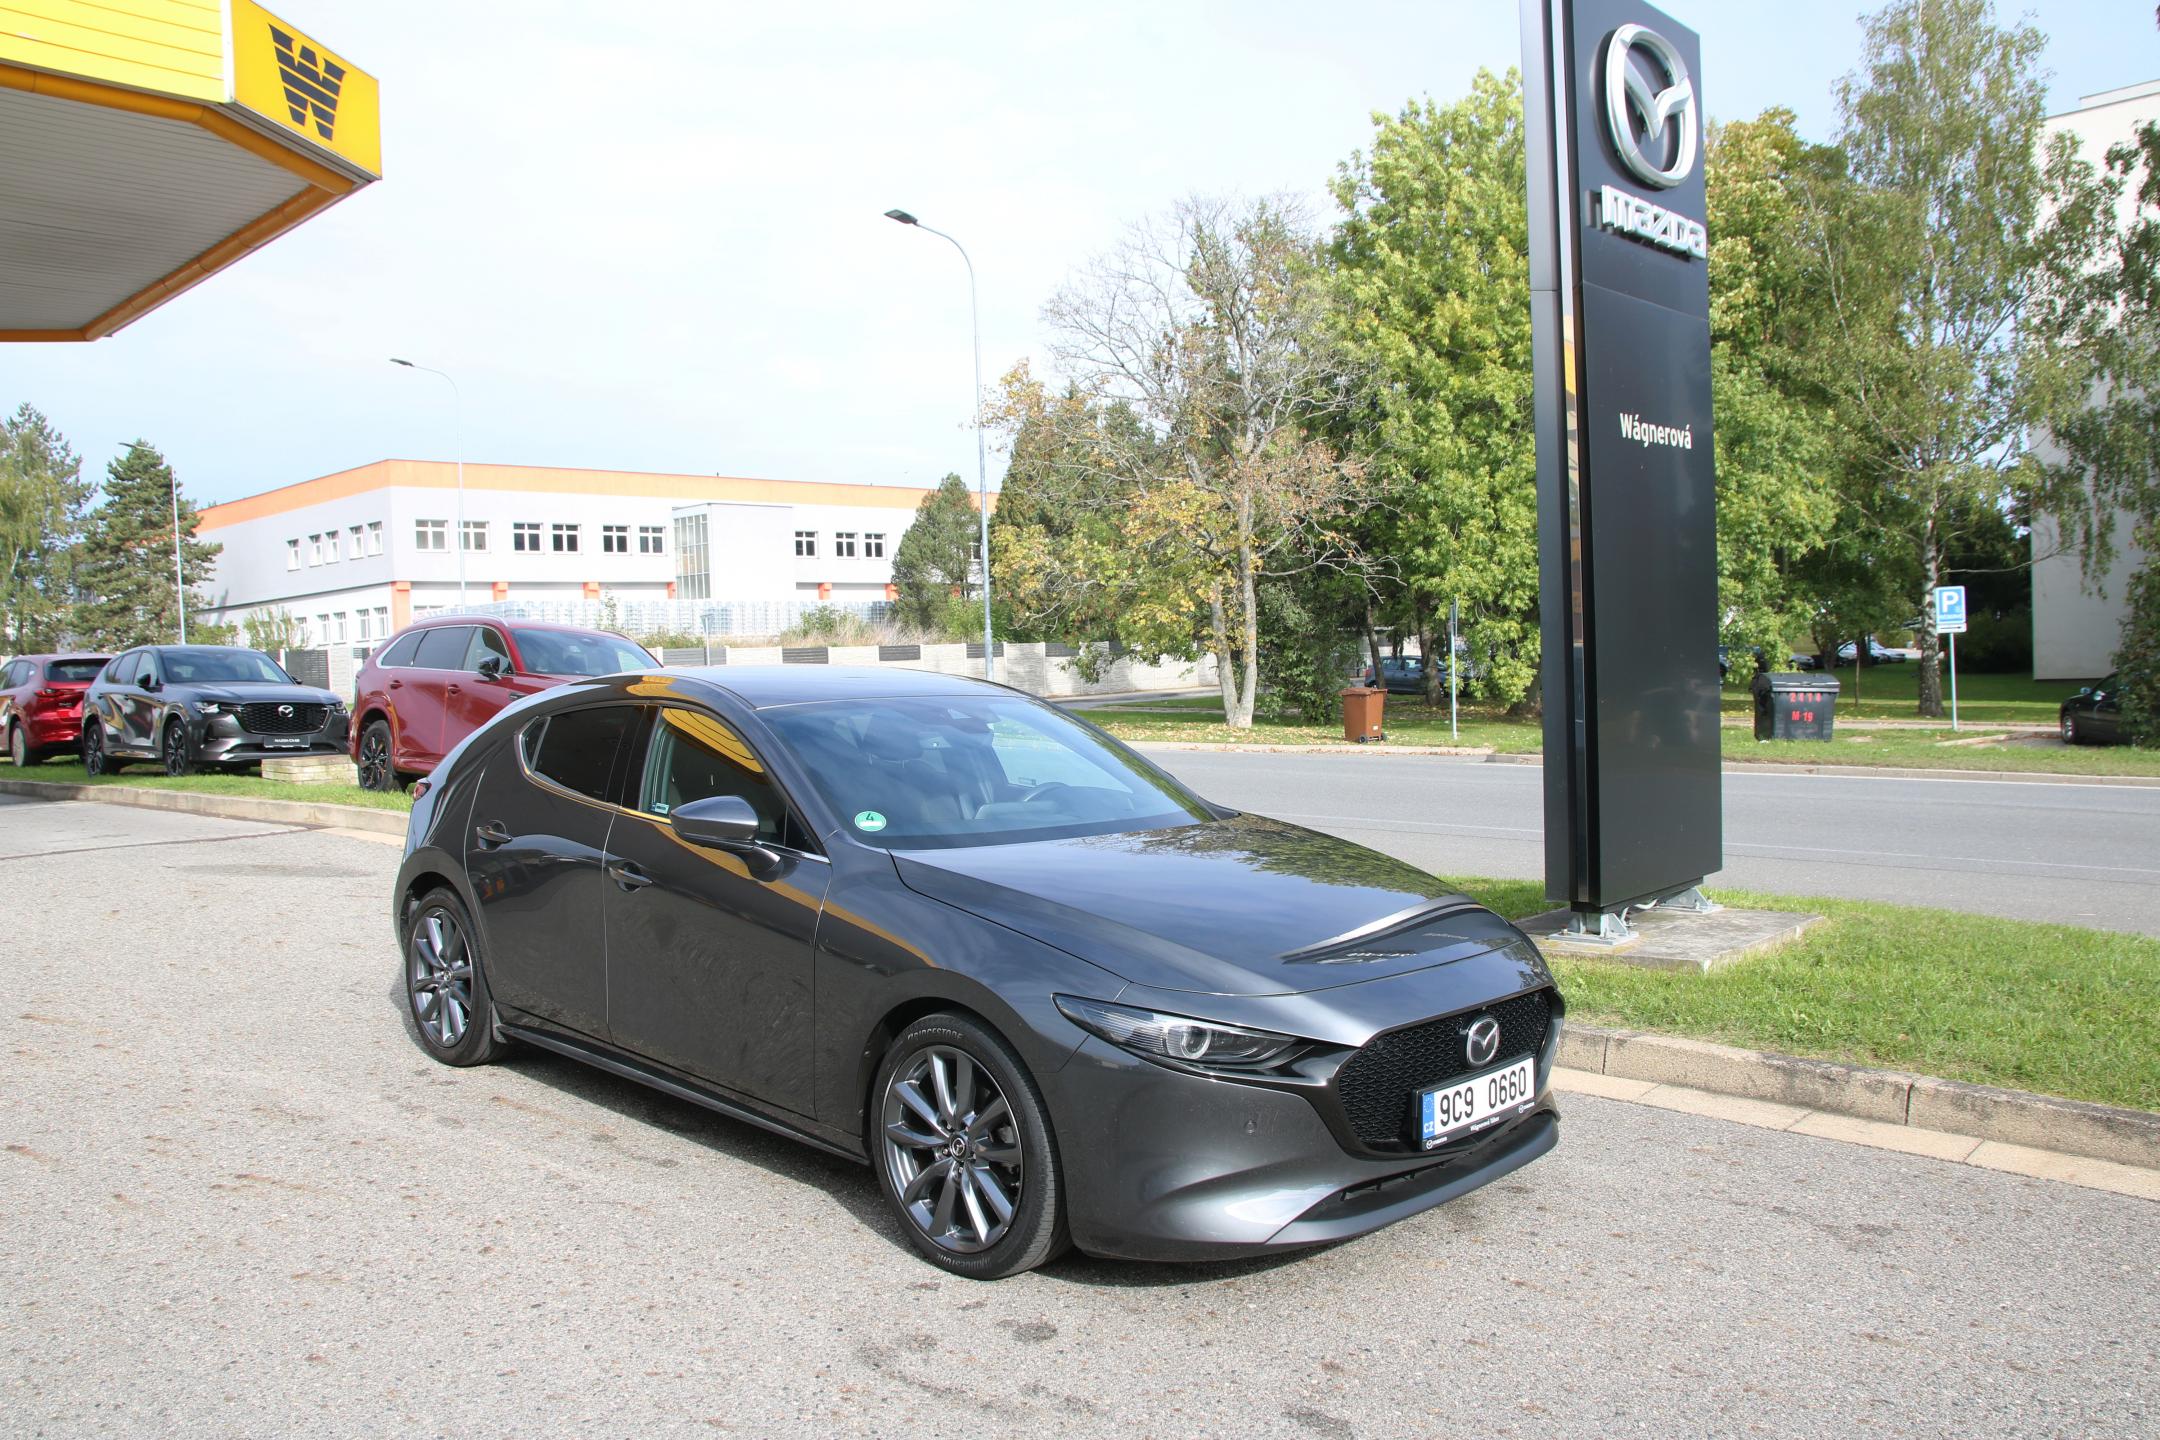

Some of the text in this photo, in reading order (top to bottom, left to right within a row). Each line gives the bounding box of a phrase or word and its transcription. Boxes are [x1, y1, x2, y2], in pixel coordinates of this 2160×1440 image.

[1601, 185, 1707, 259] mazda
[1620, 412, 1692, 449] Wágnerová
[1942, 591, 1959, 613] P
[866, 813, 874, 821] 4
[1440, 1066, 1527, 1127] 9C9 0660
[1423, 1121, 1435, 1134] CZ
